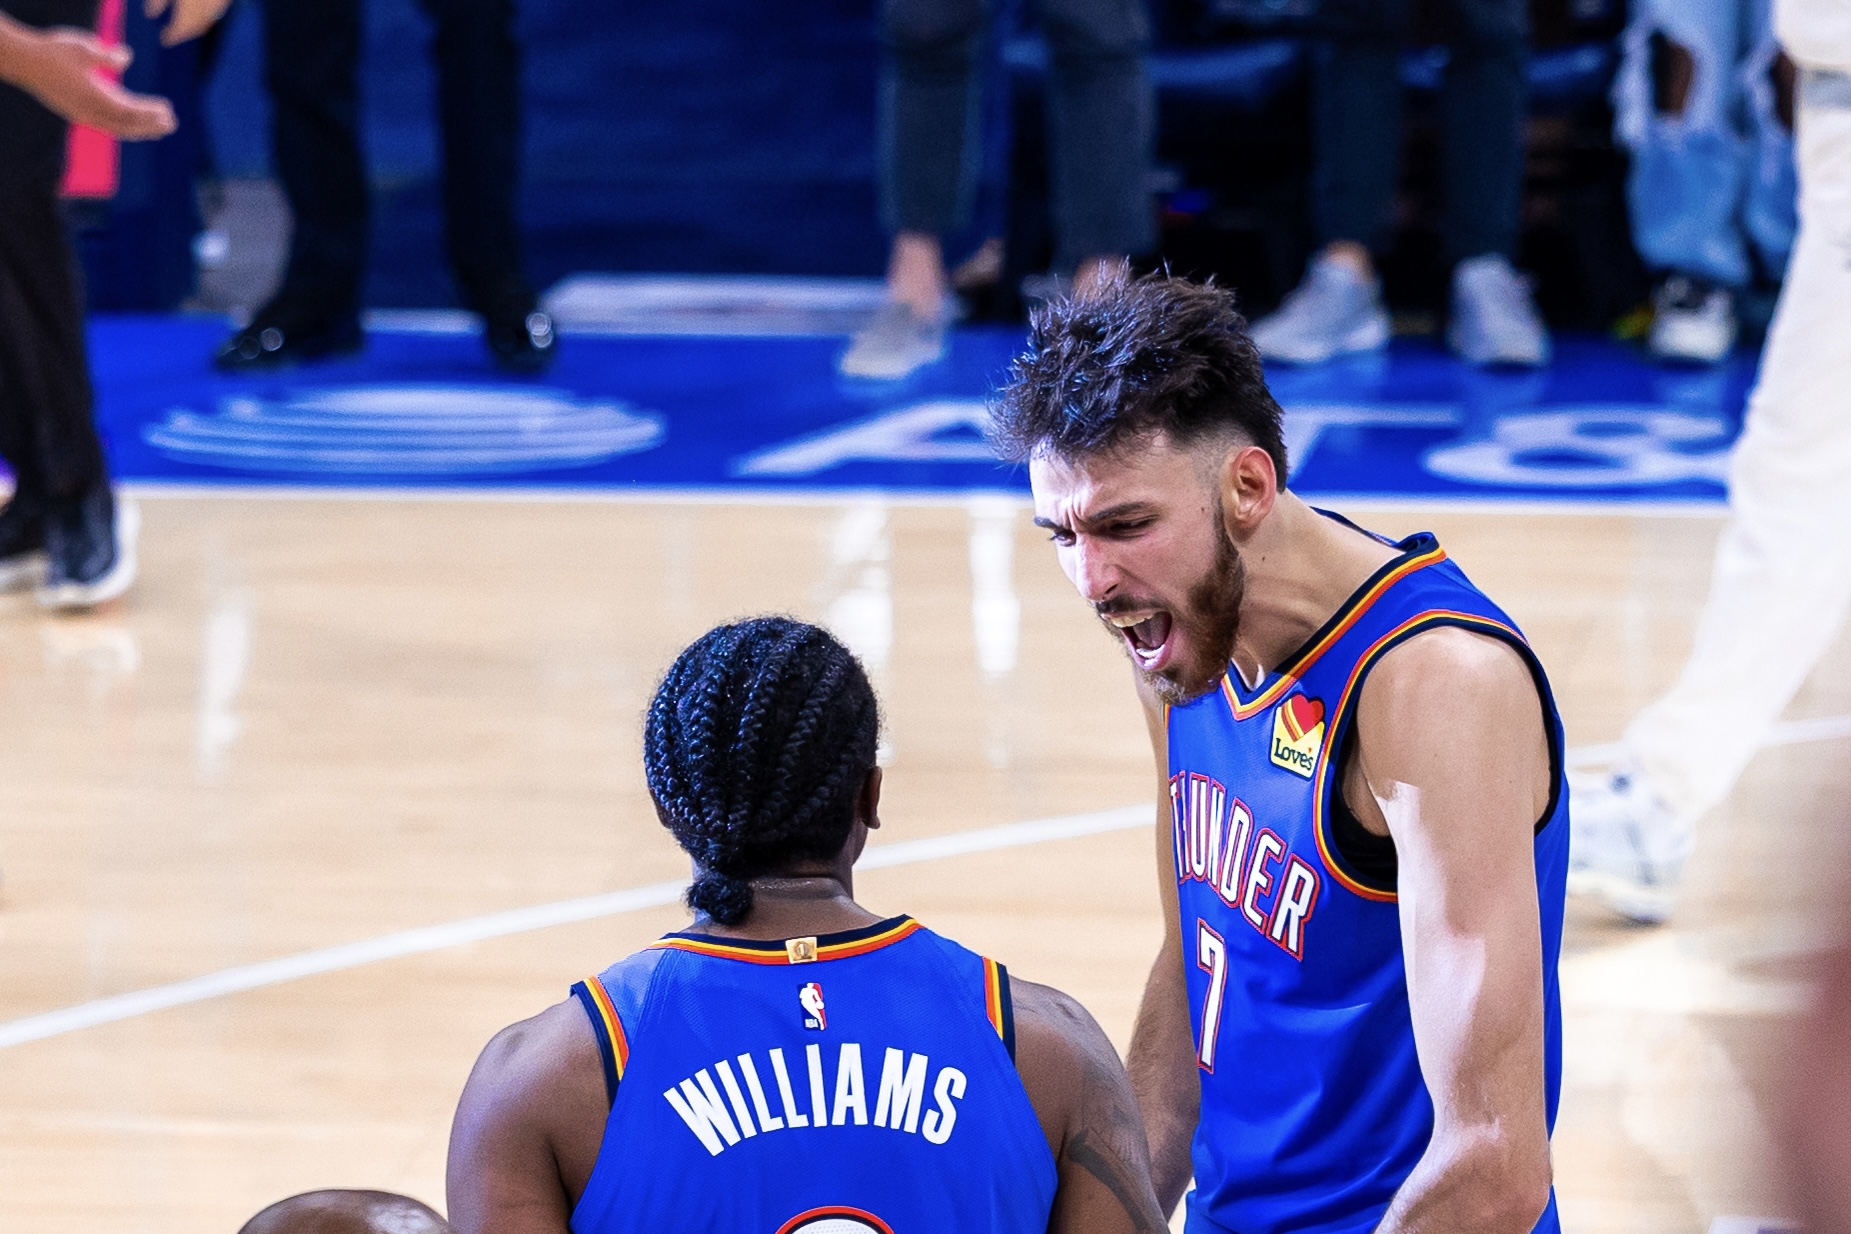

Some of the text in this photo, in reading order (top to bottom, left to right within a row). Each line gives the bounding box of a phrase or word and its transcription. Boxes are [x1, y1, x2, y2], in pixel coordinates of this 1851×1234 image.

[1274, 737, 1314, 771] Love's
[1197, 917, 1227, 1075] 7
[663, 1042, 968, 1158] WILLIAMS
